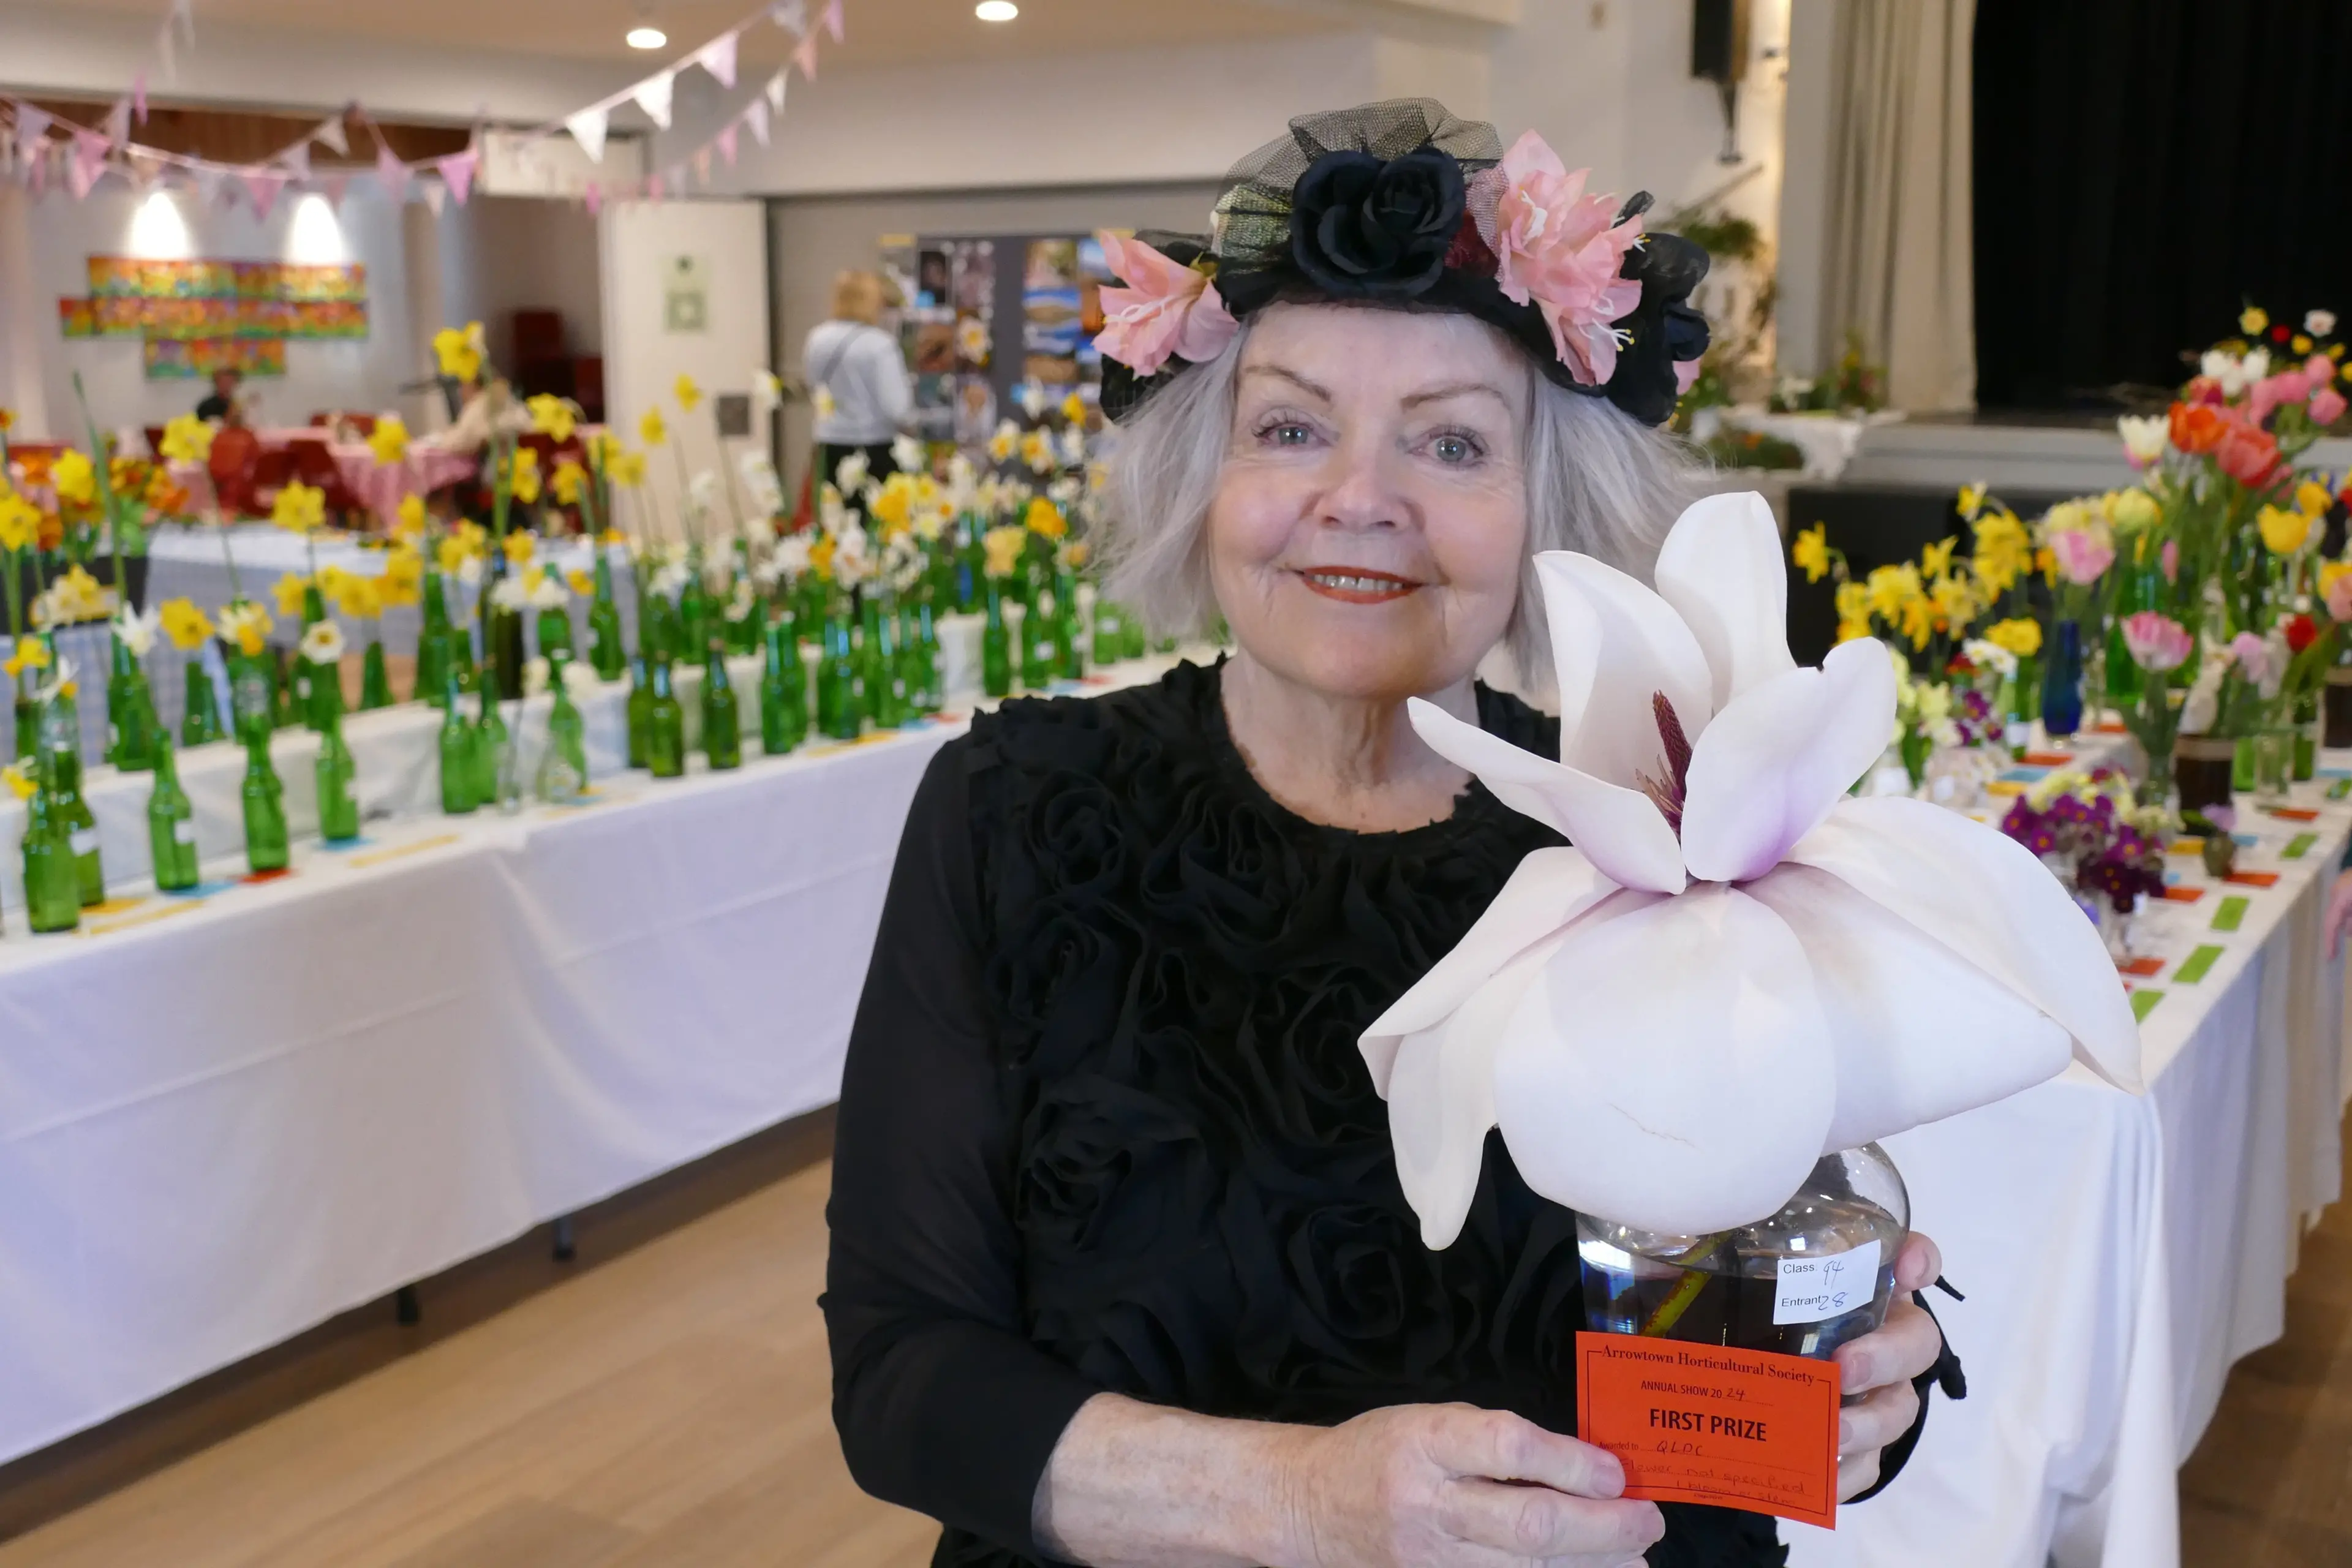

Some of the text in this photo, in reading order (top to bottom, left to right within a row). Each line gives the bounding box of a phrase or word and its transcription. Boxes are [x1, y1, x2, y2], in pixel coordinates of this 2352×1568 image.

[1781, 1291, 1849, 1311] Entrant 28
[1602, 1344, 1815, 1387] Arrowtown Horticultural Society
[1640, 1380, 1678, 1394] ANNUAL
[1681, 1383, 1709, 1397] SHOW
[1649, 1408, 1767, 1442] FIRST PRIZE
[1599, 1440, 1703, 1457] Awarded to QLDC
